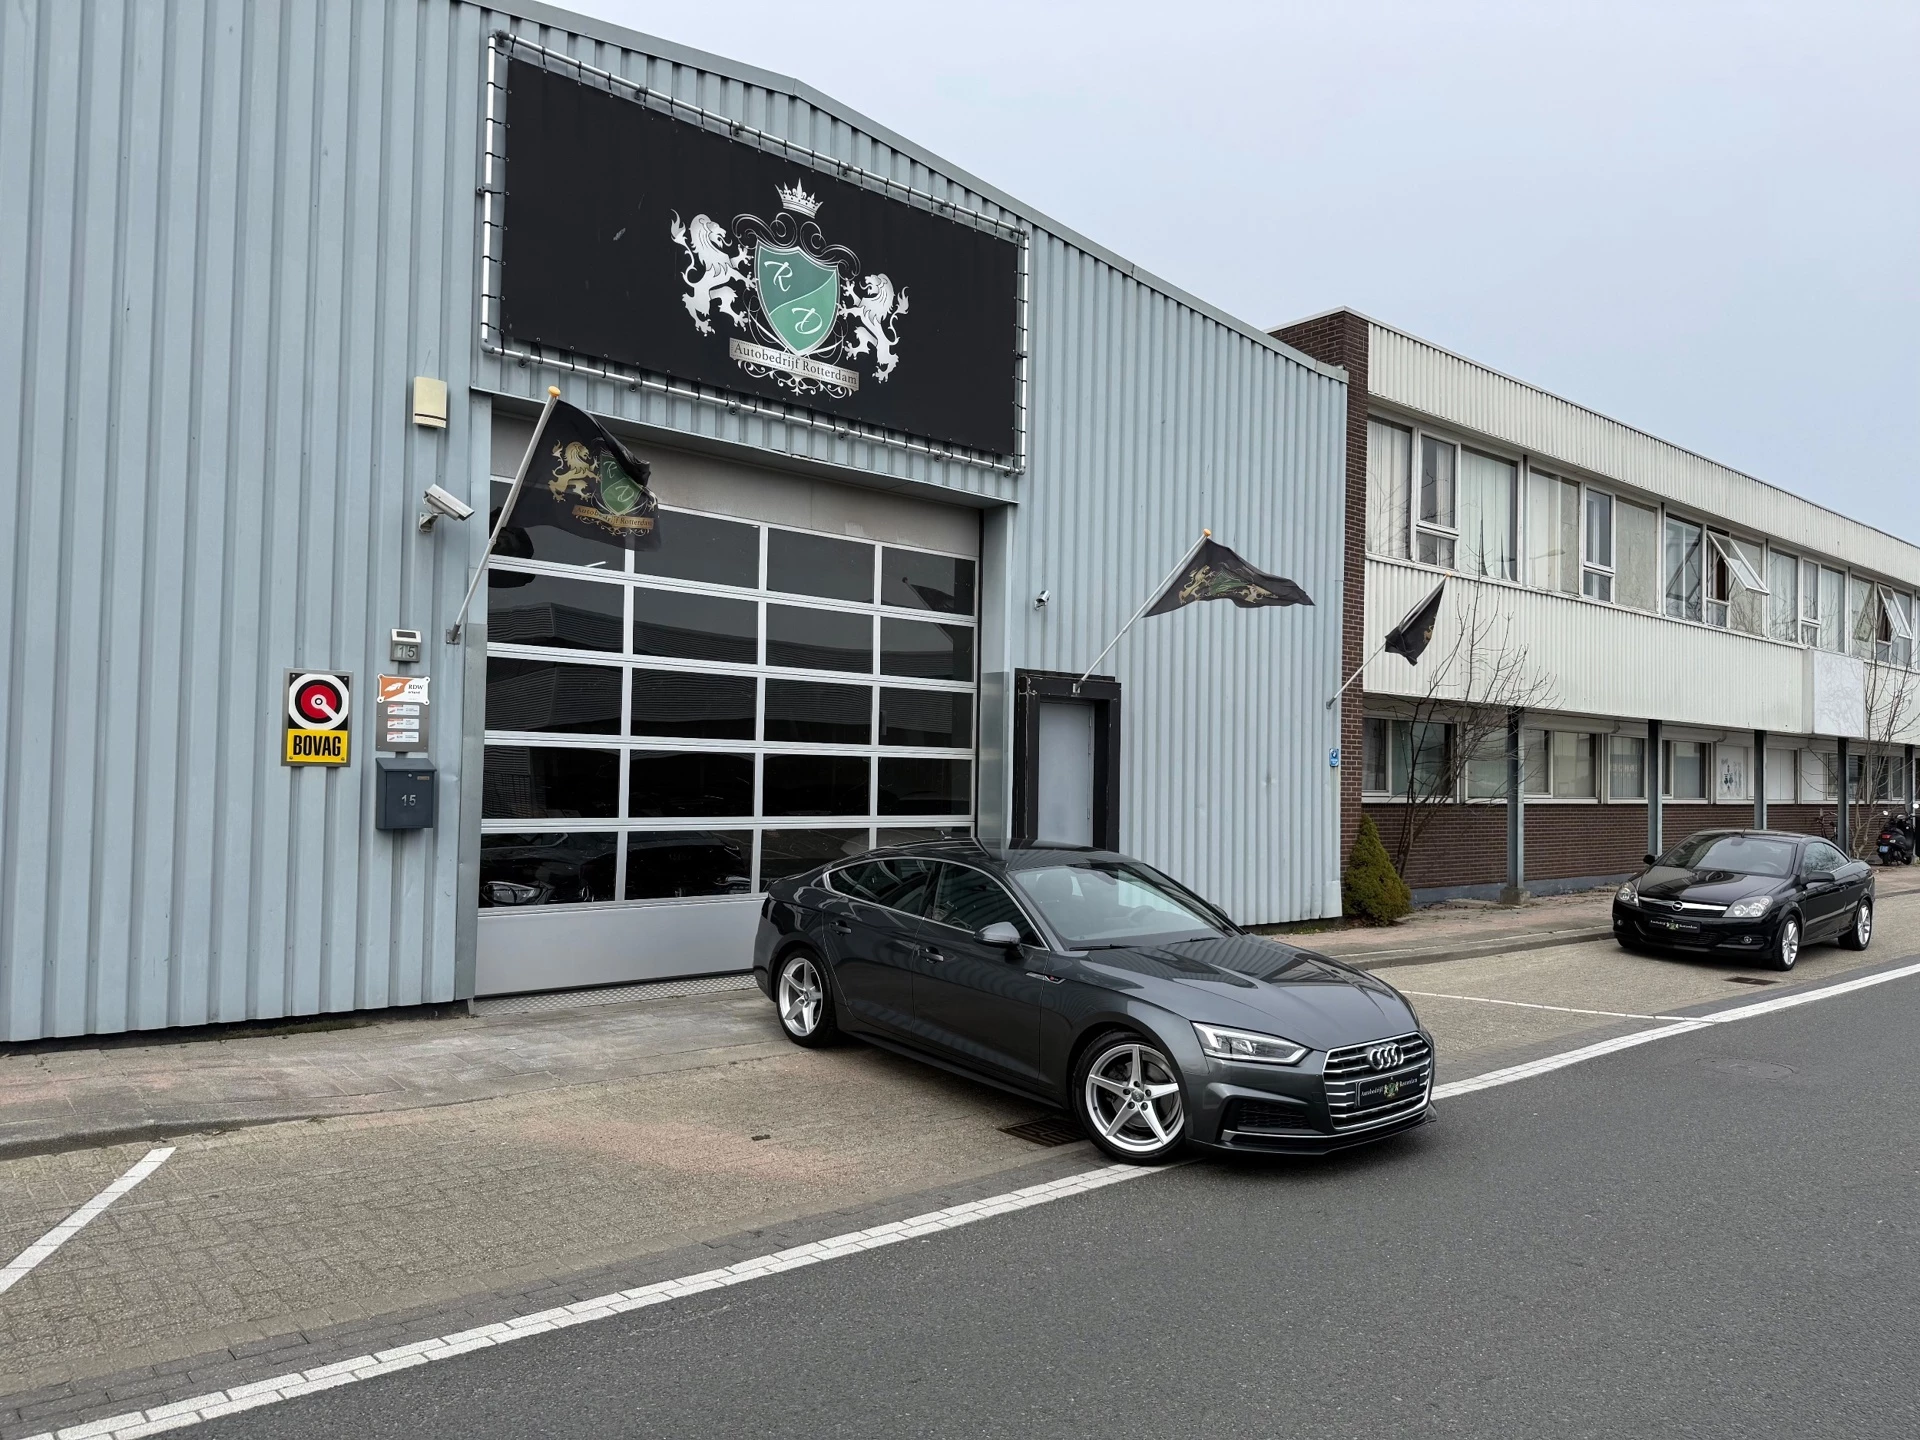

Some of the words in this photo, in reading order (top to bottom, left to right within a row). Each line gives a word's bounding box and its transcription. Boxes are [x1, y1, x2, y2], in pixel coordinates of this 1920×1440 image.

[734, 343, 801, 370] Autobedrijf
[803, 360, 857, 385] Rotterdam
[399, 645, 415, 658] 15
[293, 734, 342, 757] BOVAG
[401, 794, 416, 806] 15
